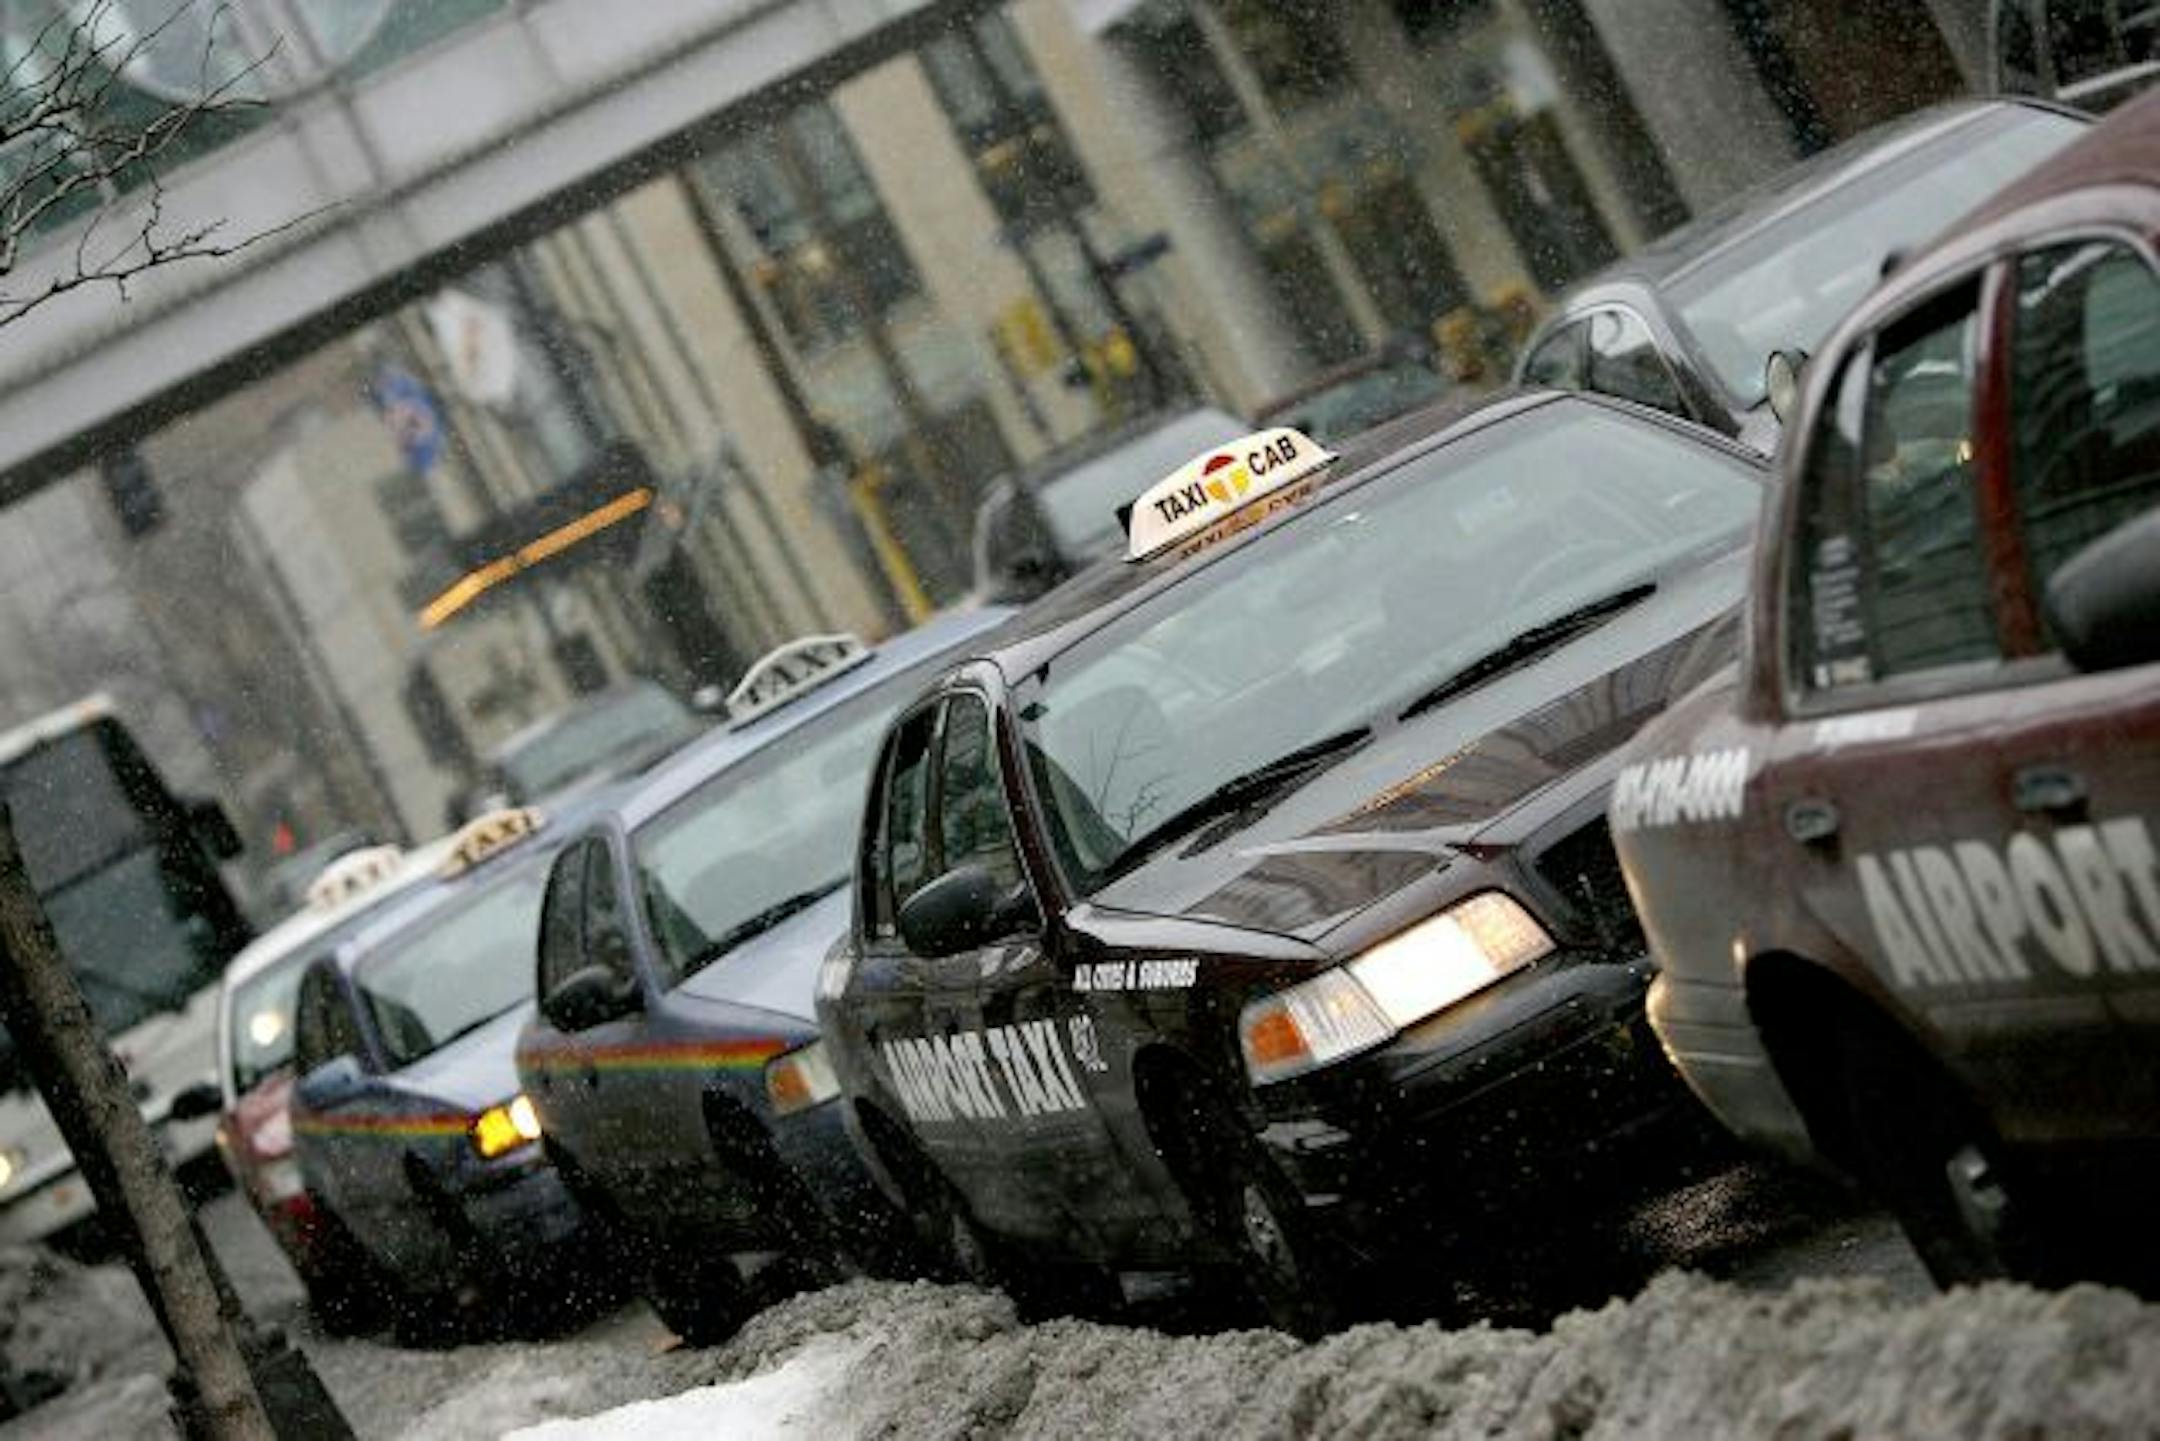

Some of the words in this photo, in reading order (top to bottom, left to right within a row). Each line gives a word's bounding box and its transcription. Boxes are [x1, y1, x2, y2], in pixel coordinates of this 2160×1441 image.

[1154, 482, 1208, 524] TAXI
[1248, 436, 1297, 476] CAB
[740, 642, 851, 705] TAXI
[454, 812, 531, 868] TAXI
[1856, 816, 2160, 988] AIRPORT
[883, 1029, 1006, 1122] AIRPORT
[986, 1019, 1086, 1116] TAXI
